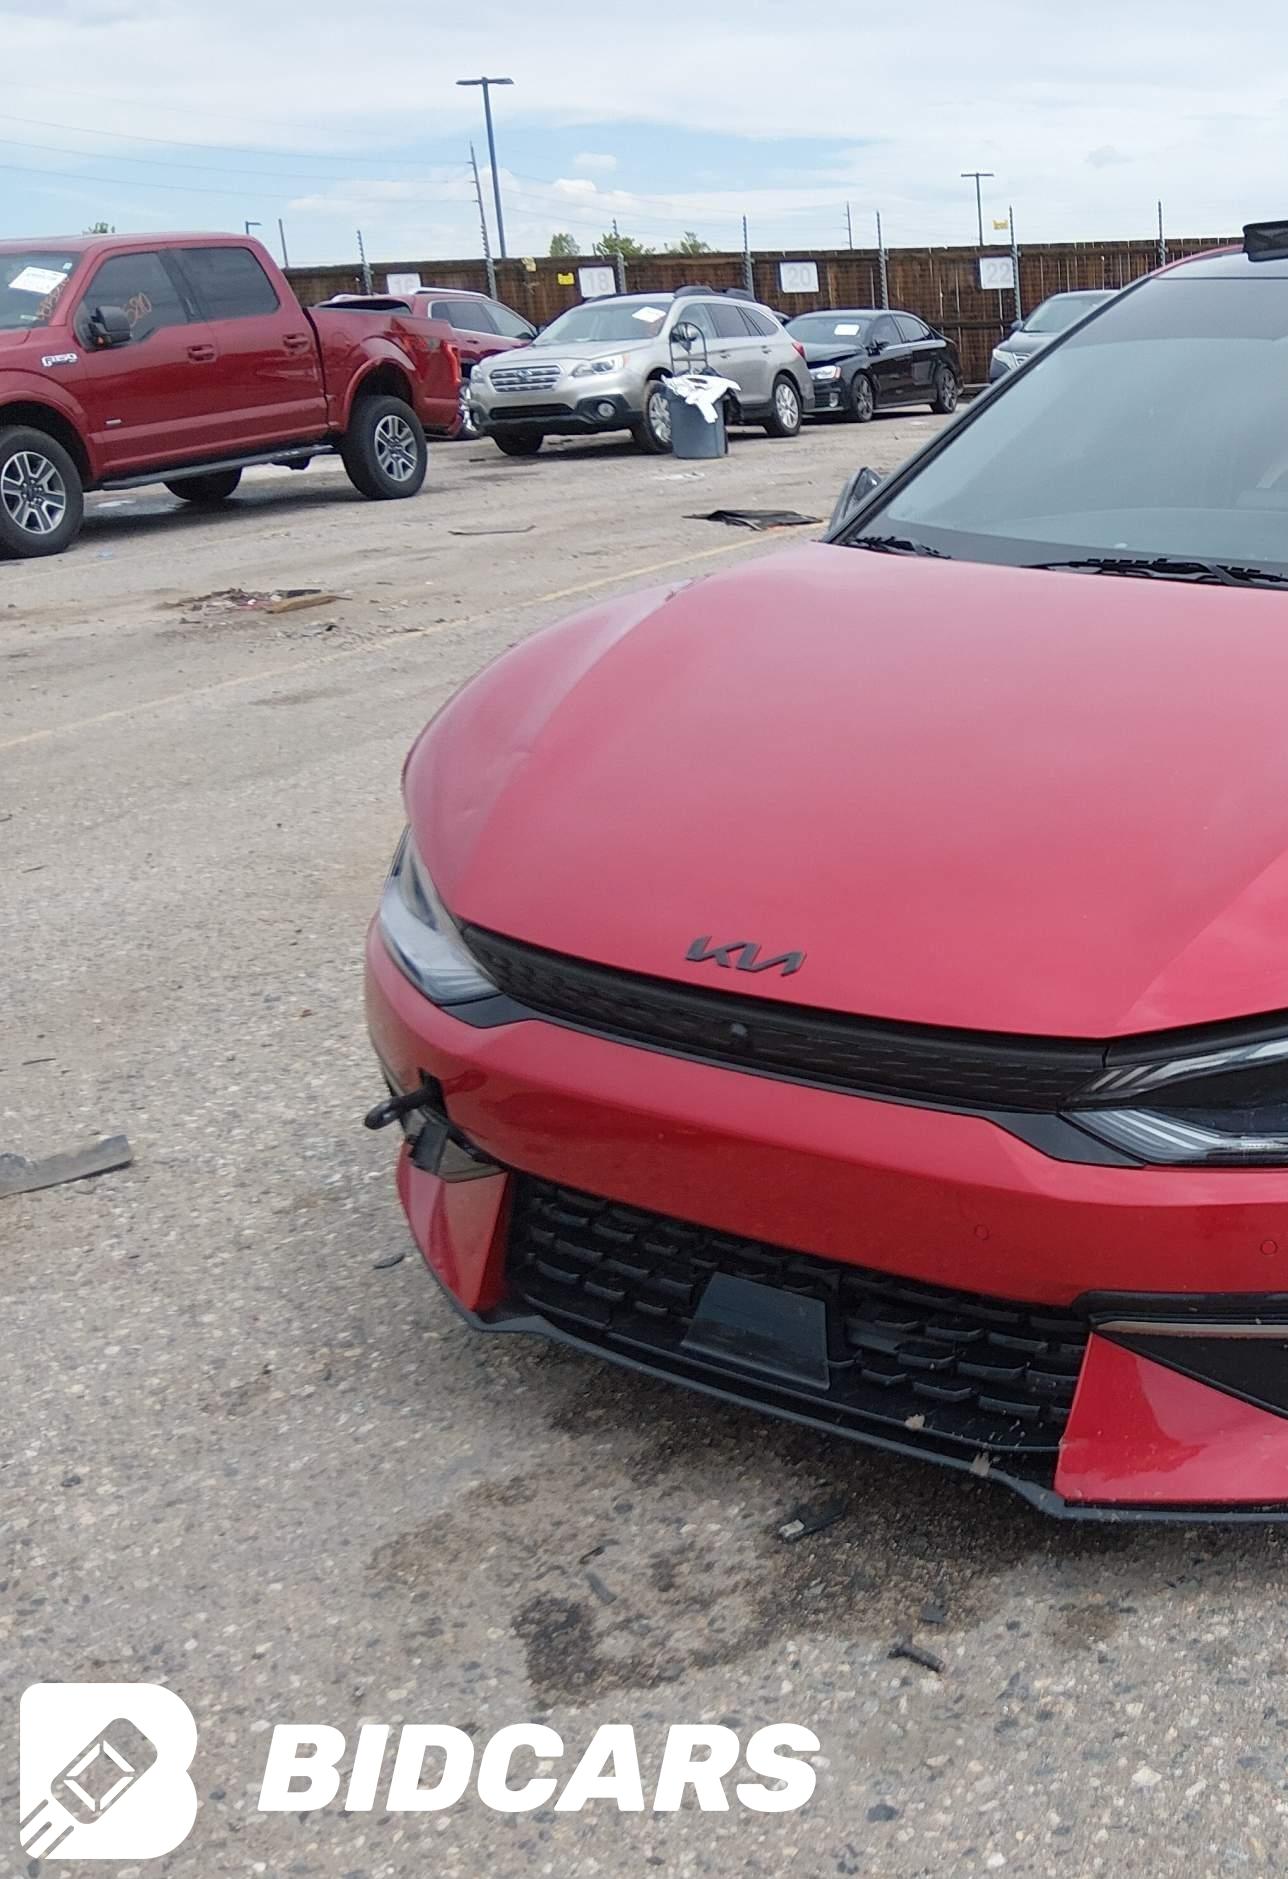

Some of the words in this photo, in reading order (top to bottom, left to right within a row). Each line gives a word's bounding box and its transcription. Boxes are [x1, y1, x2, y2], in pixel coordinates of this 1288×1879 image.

[586, 271, 610, 292] 18
[787, 266, 812, 287] 20
[986, 262, 1012, 283] 22
[685, 935, 807, 977] KIA
